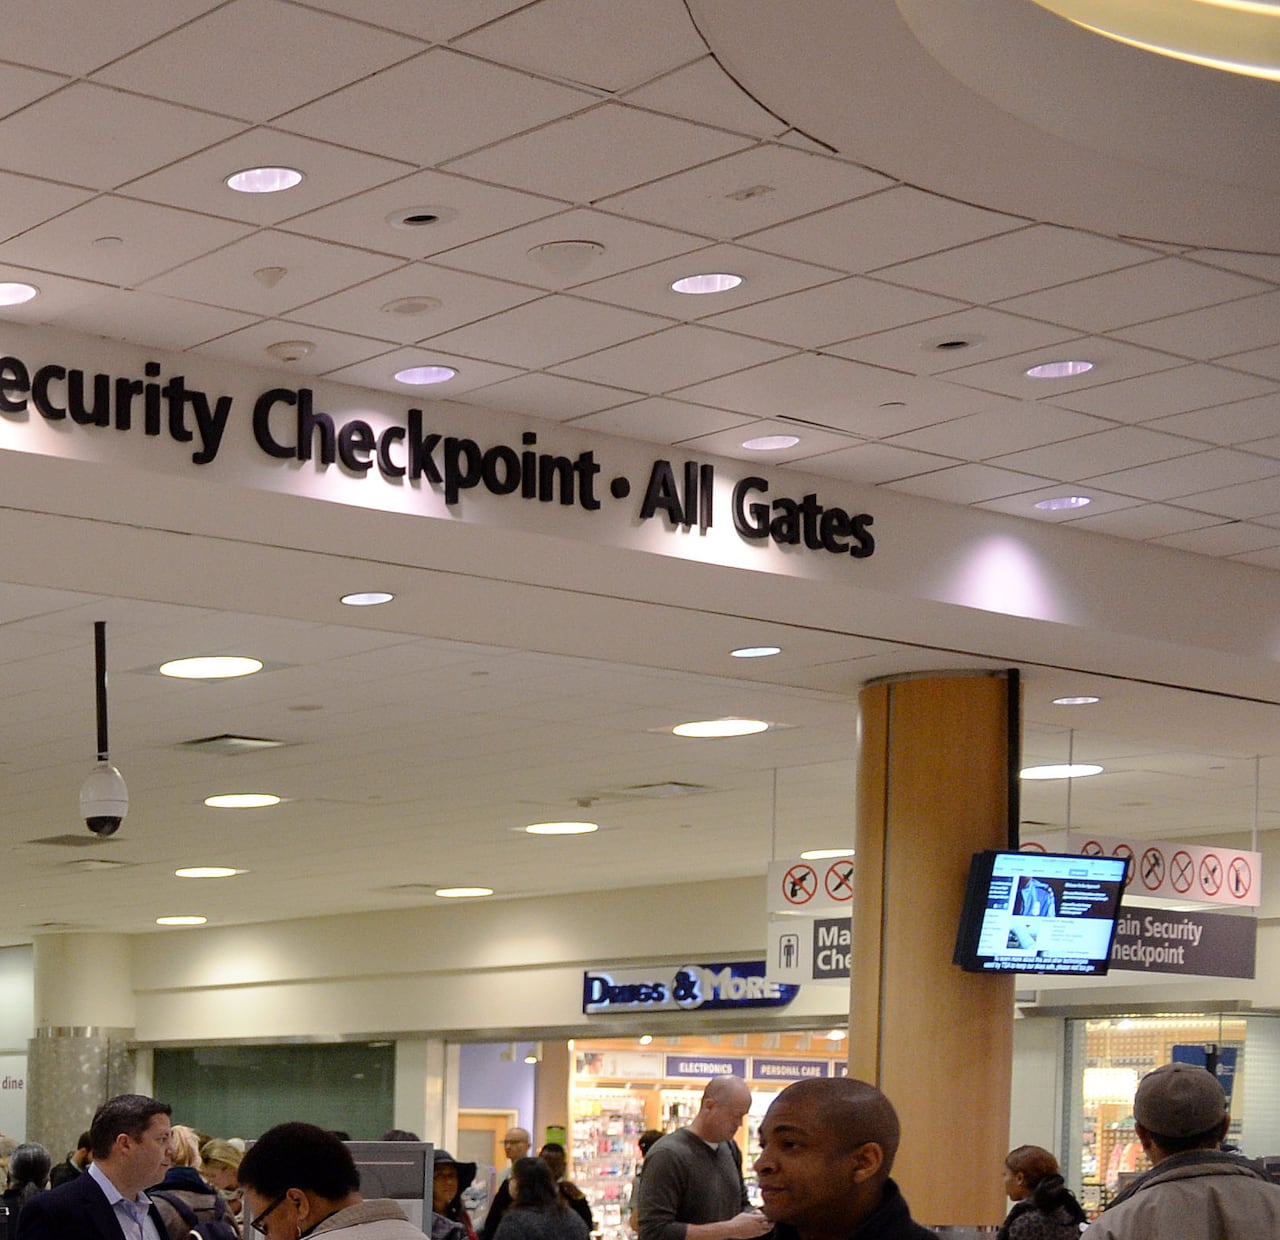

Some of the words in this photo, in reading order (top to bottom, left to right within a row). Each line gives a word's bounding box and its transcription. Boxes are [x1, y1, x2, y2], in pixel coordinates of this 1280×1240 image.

[252, 388, 601, 510] Checkpoint
[640, 459, 713, 535] All
[732, 476, 874, 558] Gates
[818, 926, 852, 947] Ma
[1117, 914, 1140, 936] ain
[1145, 917, 1203, 946] Security
[1112, 940, 1185, 967] heckpoint
[672, 971, 699, 1001] &
[679, 1062, 733, 1075] ELECTRONICS
[760, 1064, 800, 1076] PERSONAL
[801, 1066, 822, 1077] CARE
[2, 1076, 24, 1089] dine
